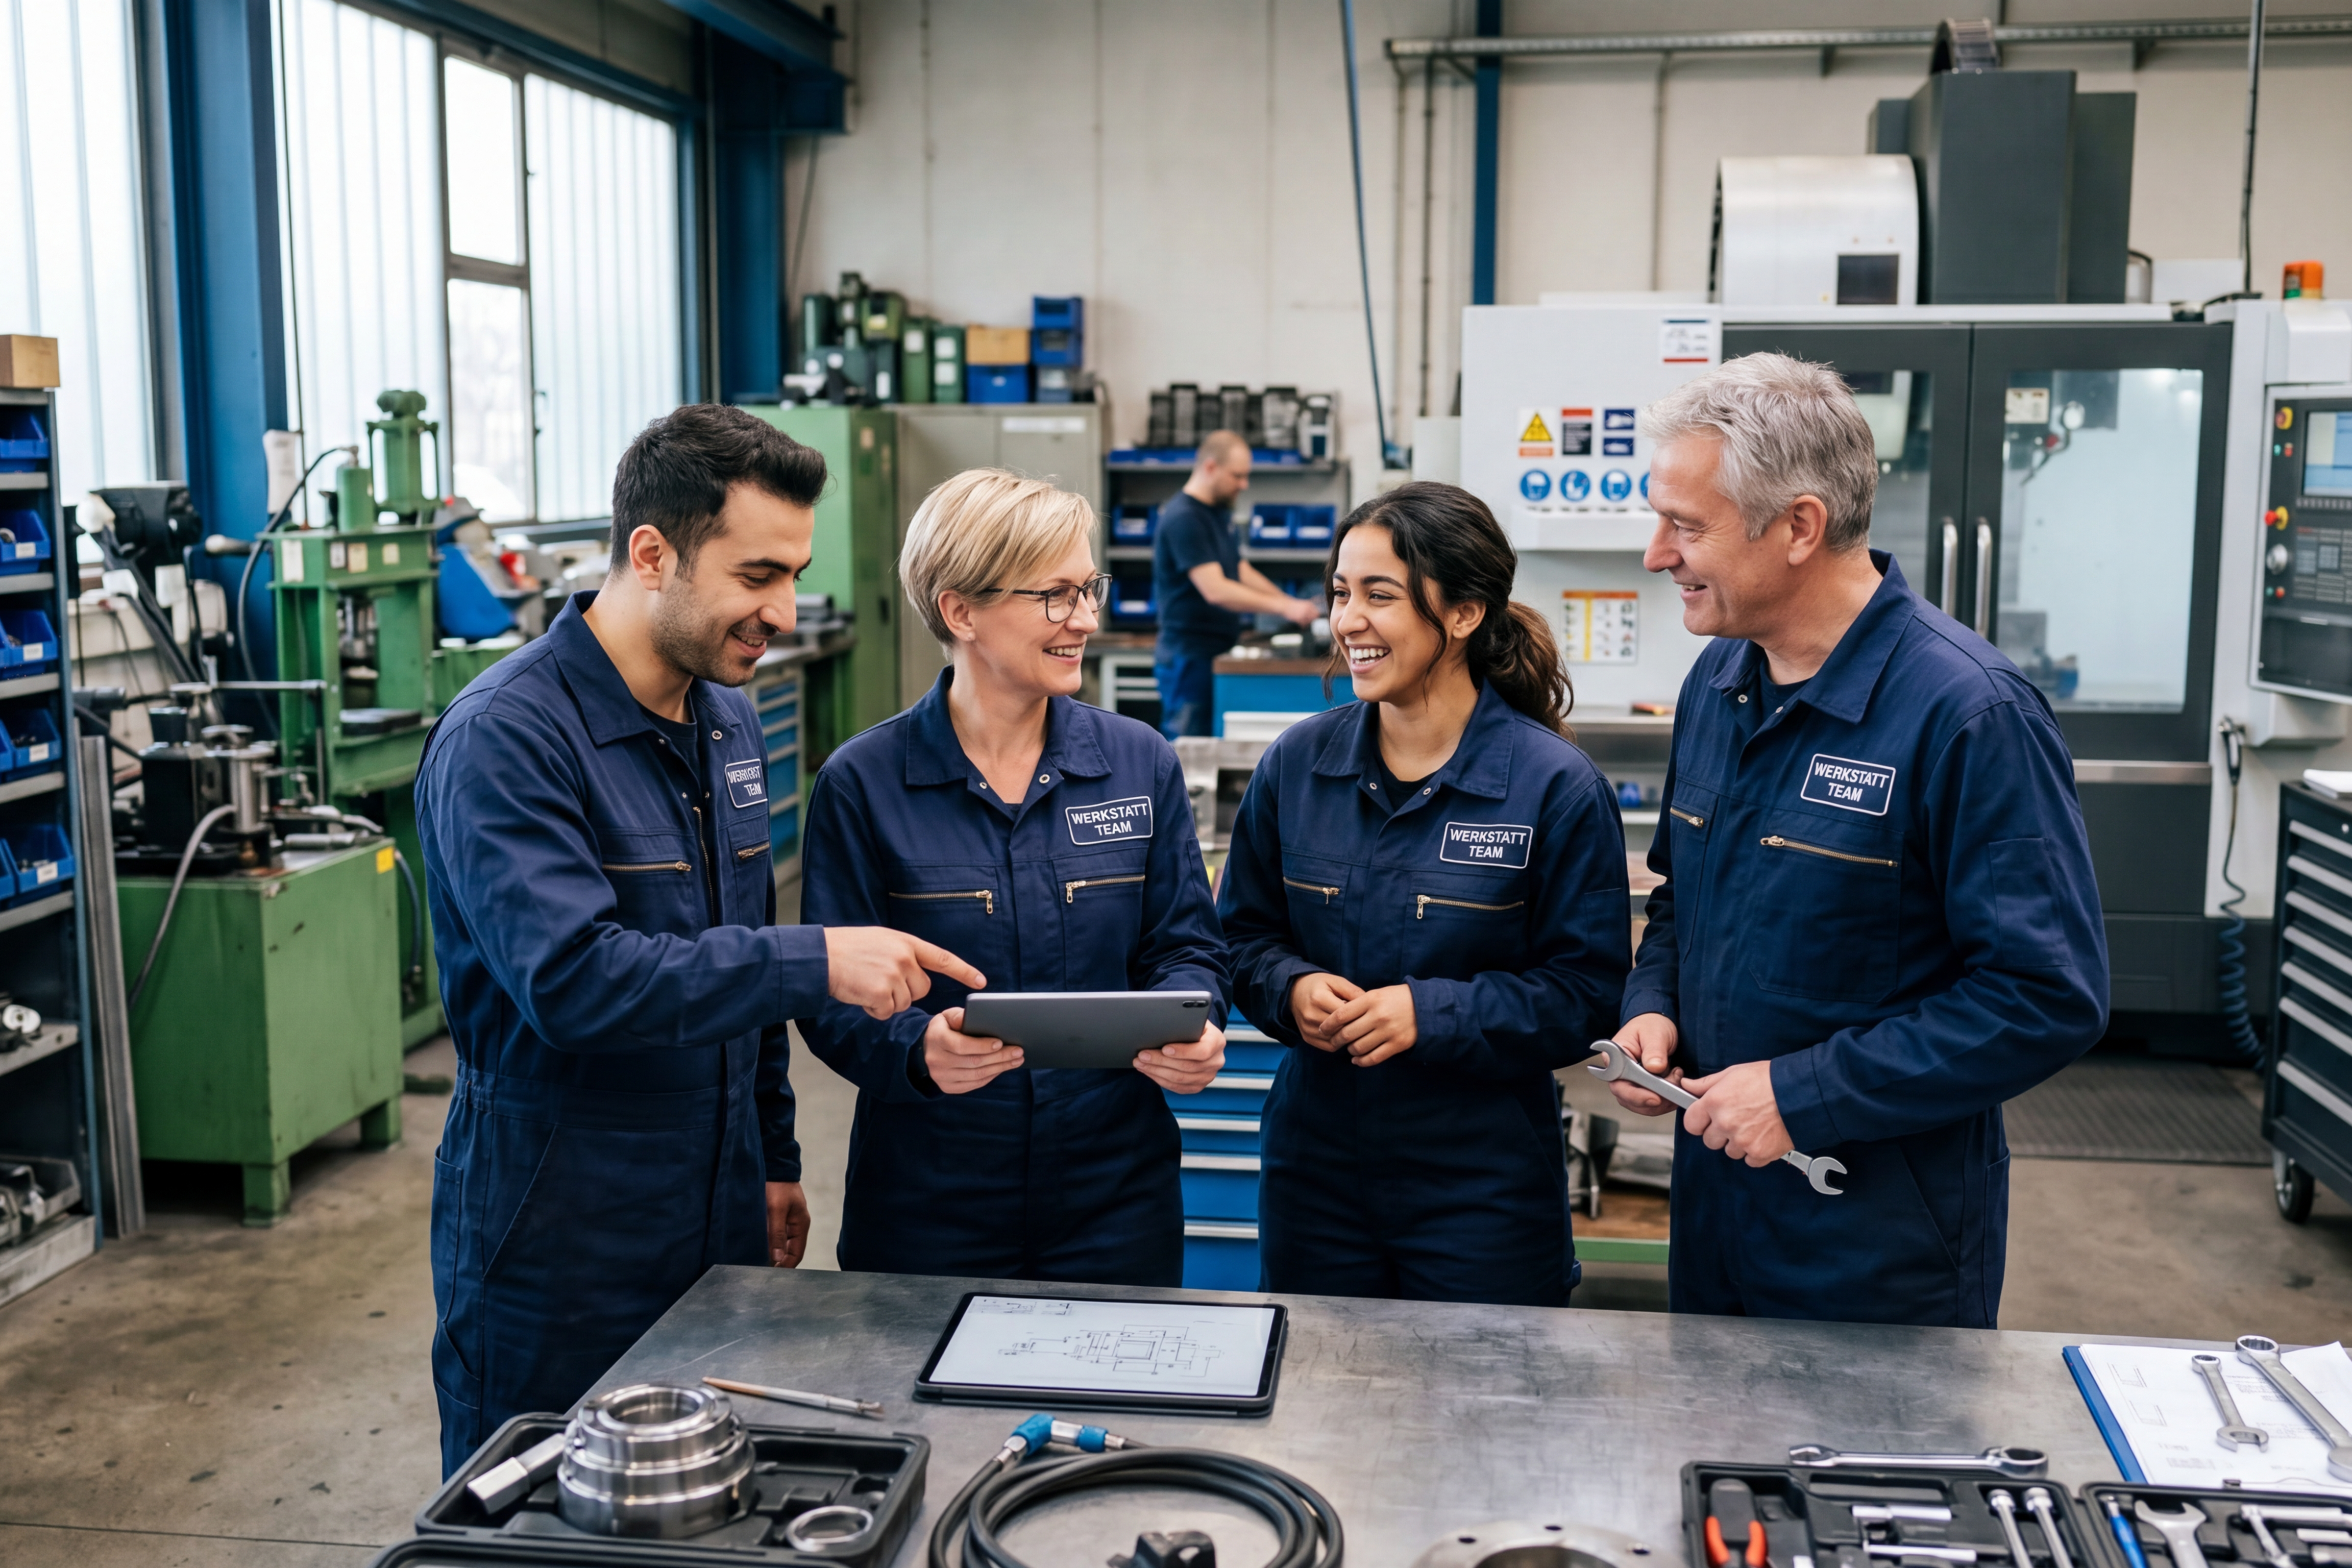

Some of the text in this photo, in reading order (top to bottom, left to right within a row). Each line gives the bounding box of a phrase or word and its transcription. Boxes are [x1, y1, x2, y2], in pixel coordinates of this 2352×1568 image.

[1815, 762, 1890, 788] WERKSTATT
[1828, 782, 1863, 802] TEAM
[1071, 803, 1147, 824] WERKSTATT
[1094, 821, 1132, 836] TEAM
[1450, 828, 1526, 845] WERKSTATT
[1469, 845, 1503, 858] TEAM
